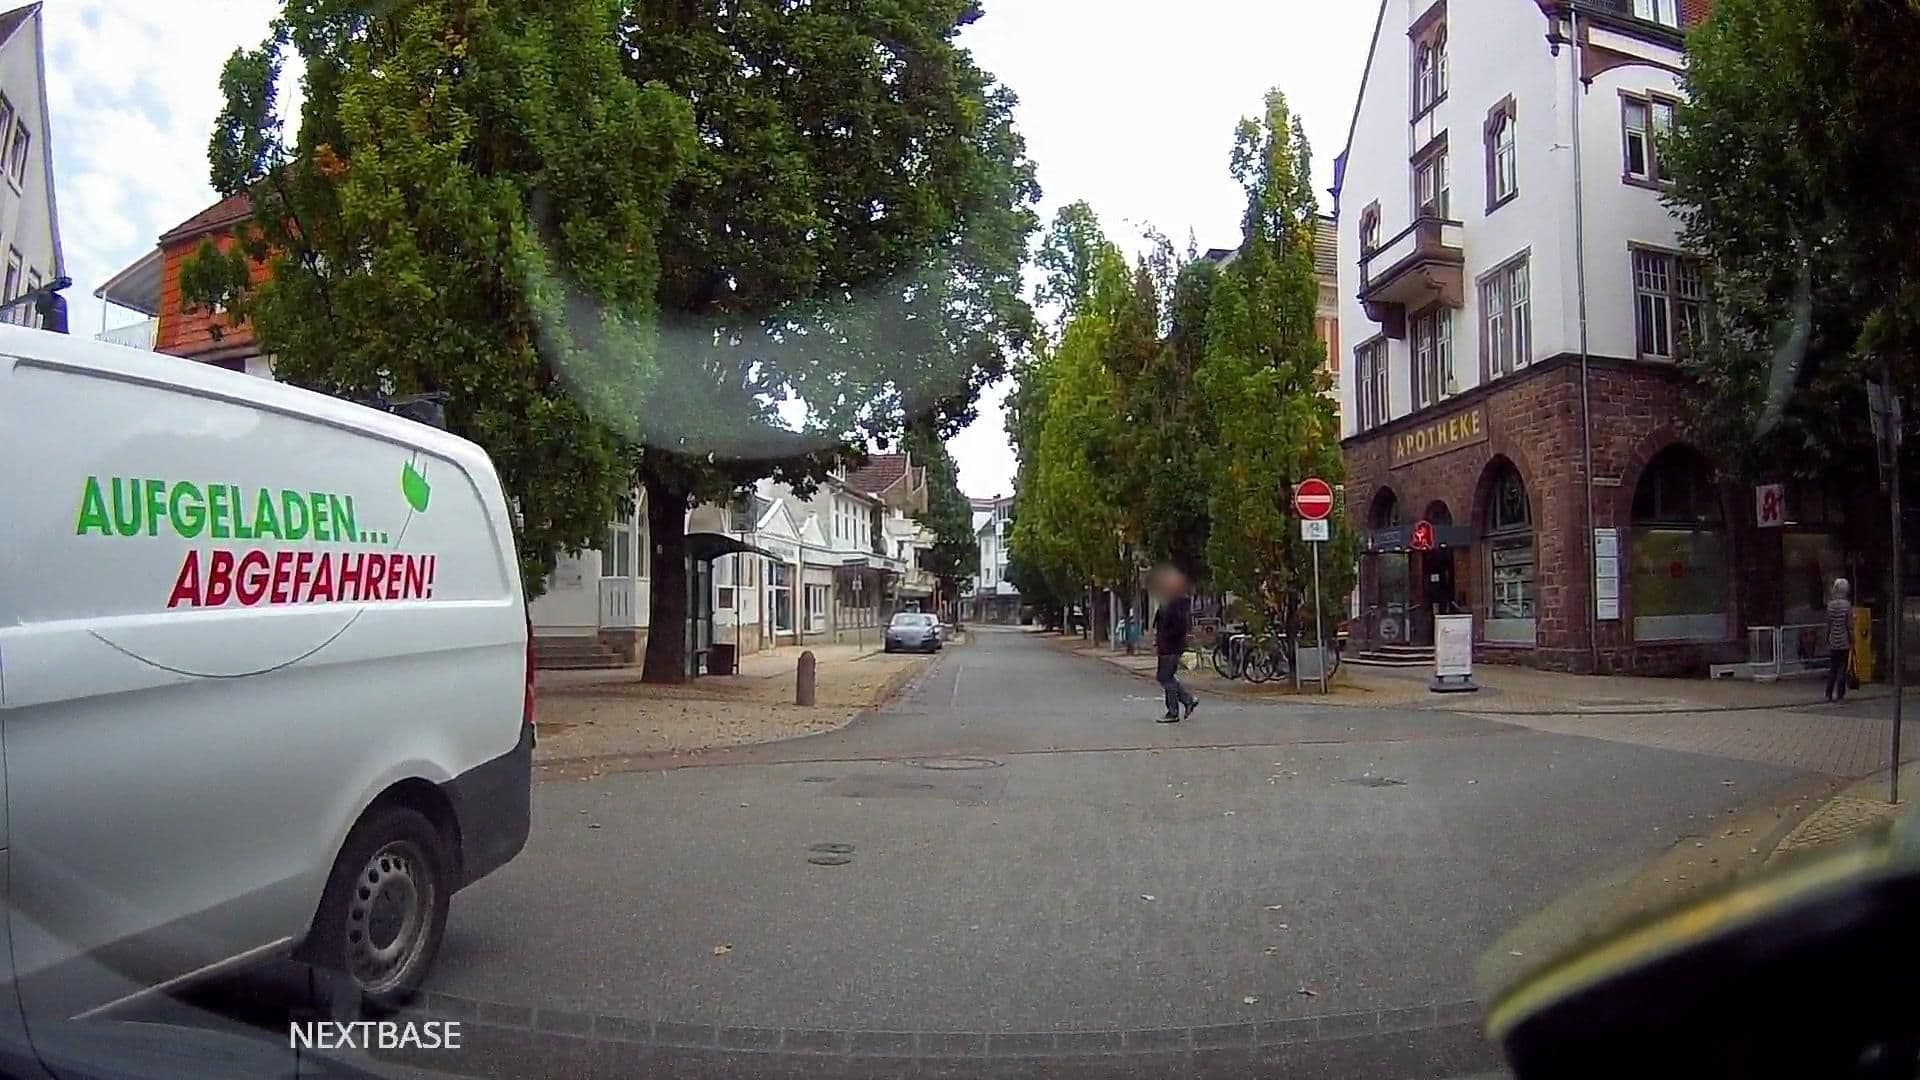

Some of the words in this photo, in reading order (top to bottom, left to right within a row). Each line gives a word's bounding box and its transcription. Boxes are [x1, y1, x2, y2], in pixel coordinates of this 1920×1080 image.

[1396, 410, 1480, 459] APOTHEKE
[76, 475, 388, 544] AUFGELADEN...
[166, 549, 436, 608] ABGEFAHREN!
